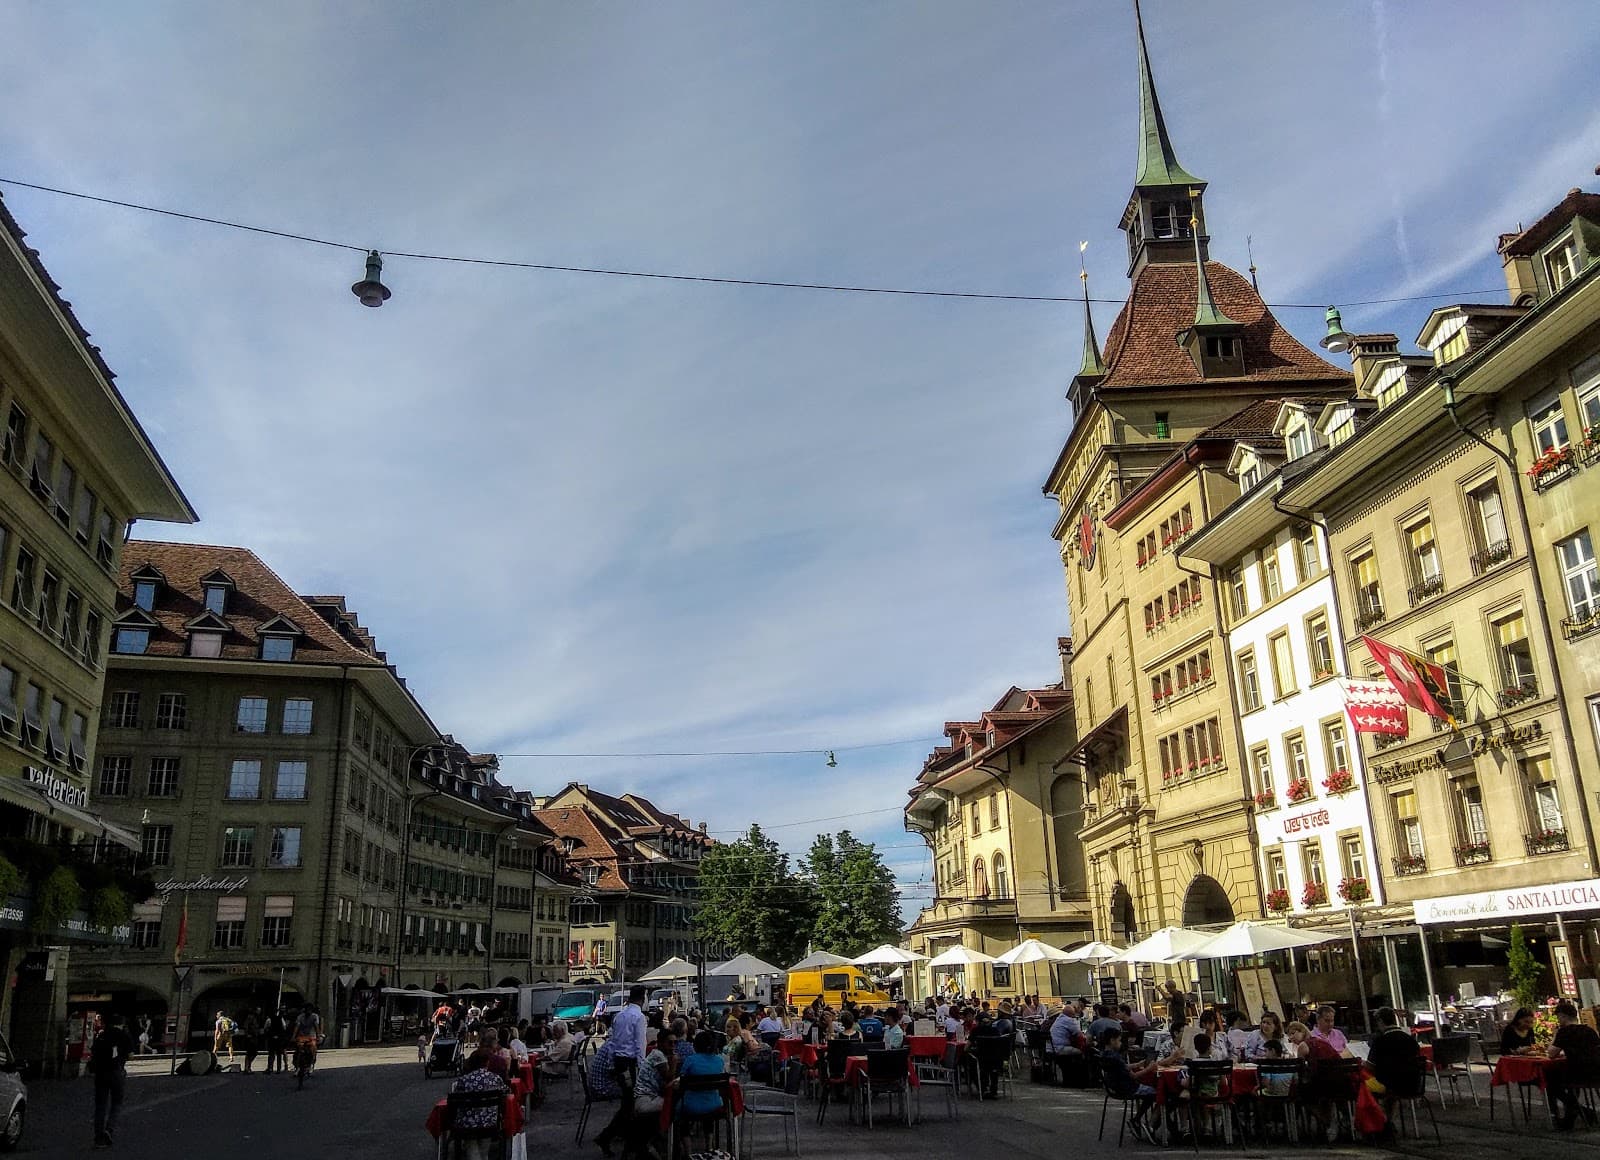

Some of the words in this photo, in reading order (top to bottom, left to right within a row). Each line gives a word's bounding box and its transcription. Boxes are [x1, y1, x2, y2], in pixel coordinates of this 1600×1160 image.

[28, 766, 88, 808] vatterland
[1507, 892, 1552, 911] SANTA
[1552, 887, 1600, 906] LUCIA
